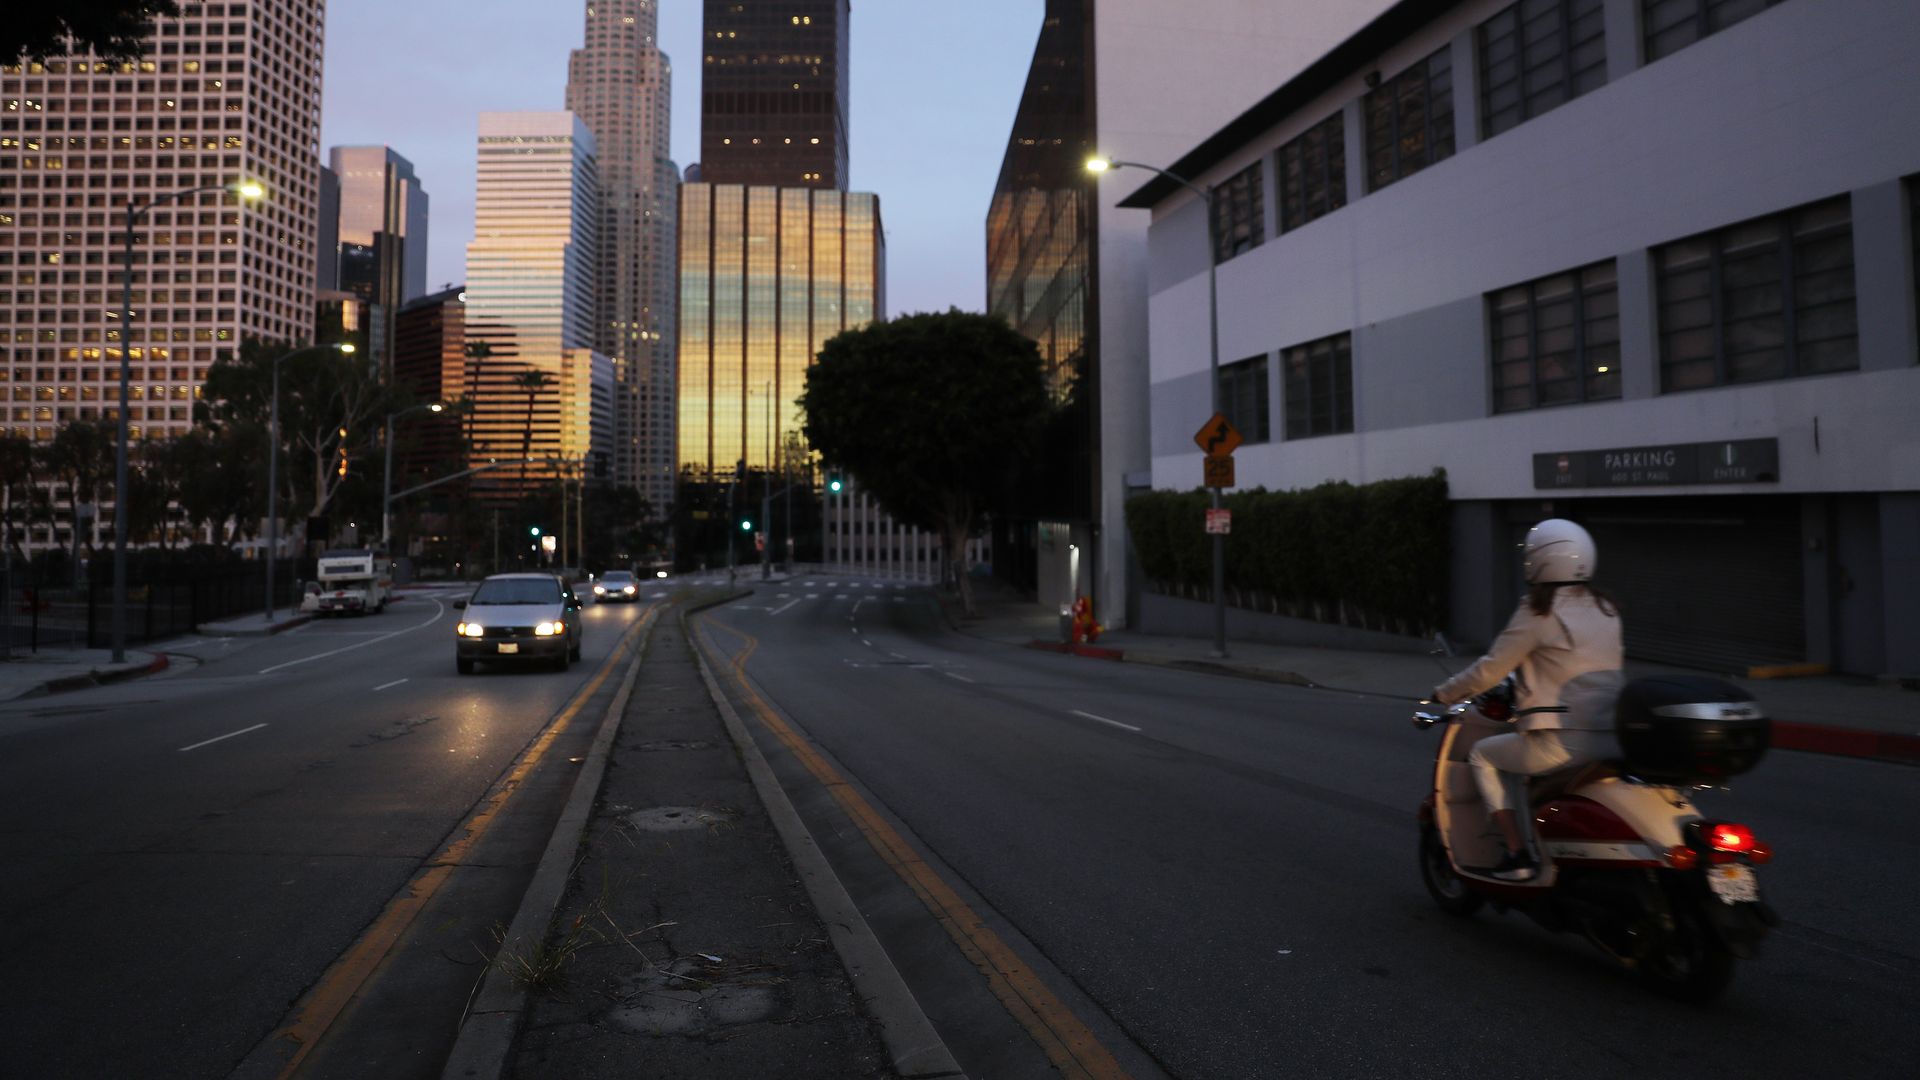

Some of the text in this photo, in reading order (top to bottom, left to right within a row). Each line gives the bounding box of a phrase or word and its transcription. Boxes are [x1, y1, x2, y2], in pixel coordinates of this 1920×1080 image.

[1209, 459, 1230, 476] 25
[1605, 450, 1676, 468] PARKING
[1714, 467, 1746, 479] ENTER
